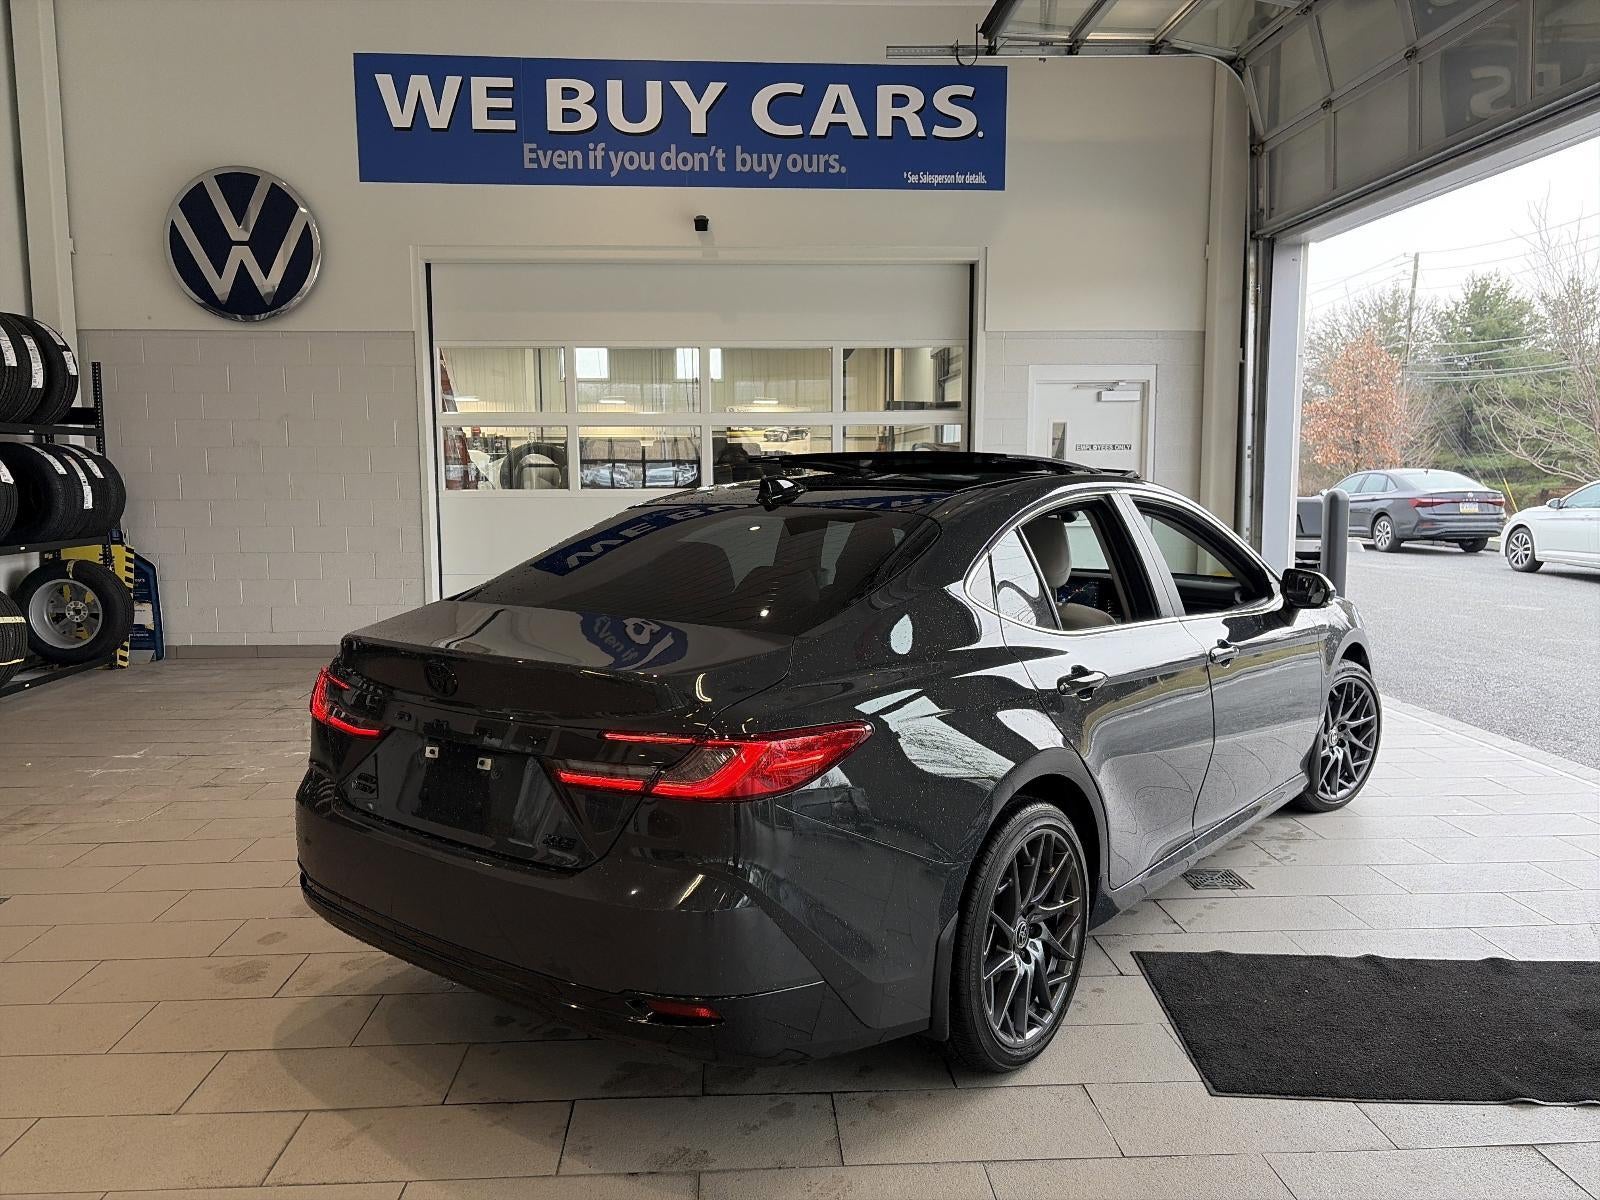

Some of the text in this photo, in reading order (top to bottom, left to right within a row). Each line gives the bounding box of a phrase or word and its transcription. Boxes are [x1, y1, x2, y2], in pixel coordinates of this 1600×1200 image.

[374, 73, 517, 133] WE
[545, 78, 728, 136] BUY
[523, 142, 847, 180] Even if you don’t buy ours.
[919, 171, 955, 186] Salesperson
[955, 171, 964, 183] for
[965, 172, 987, 184] details.
